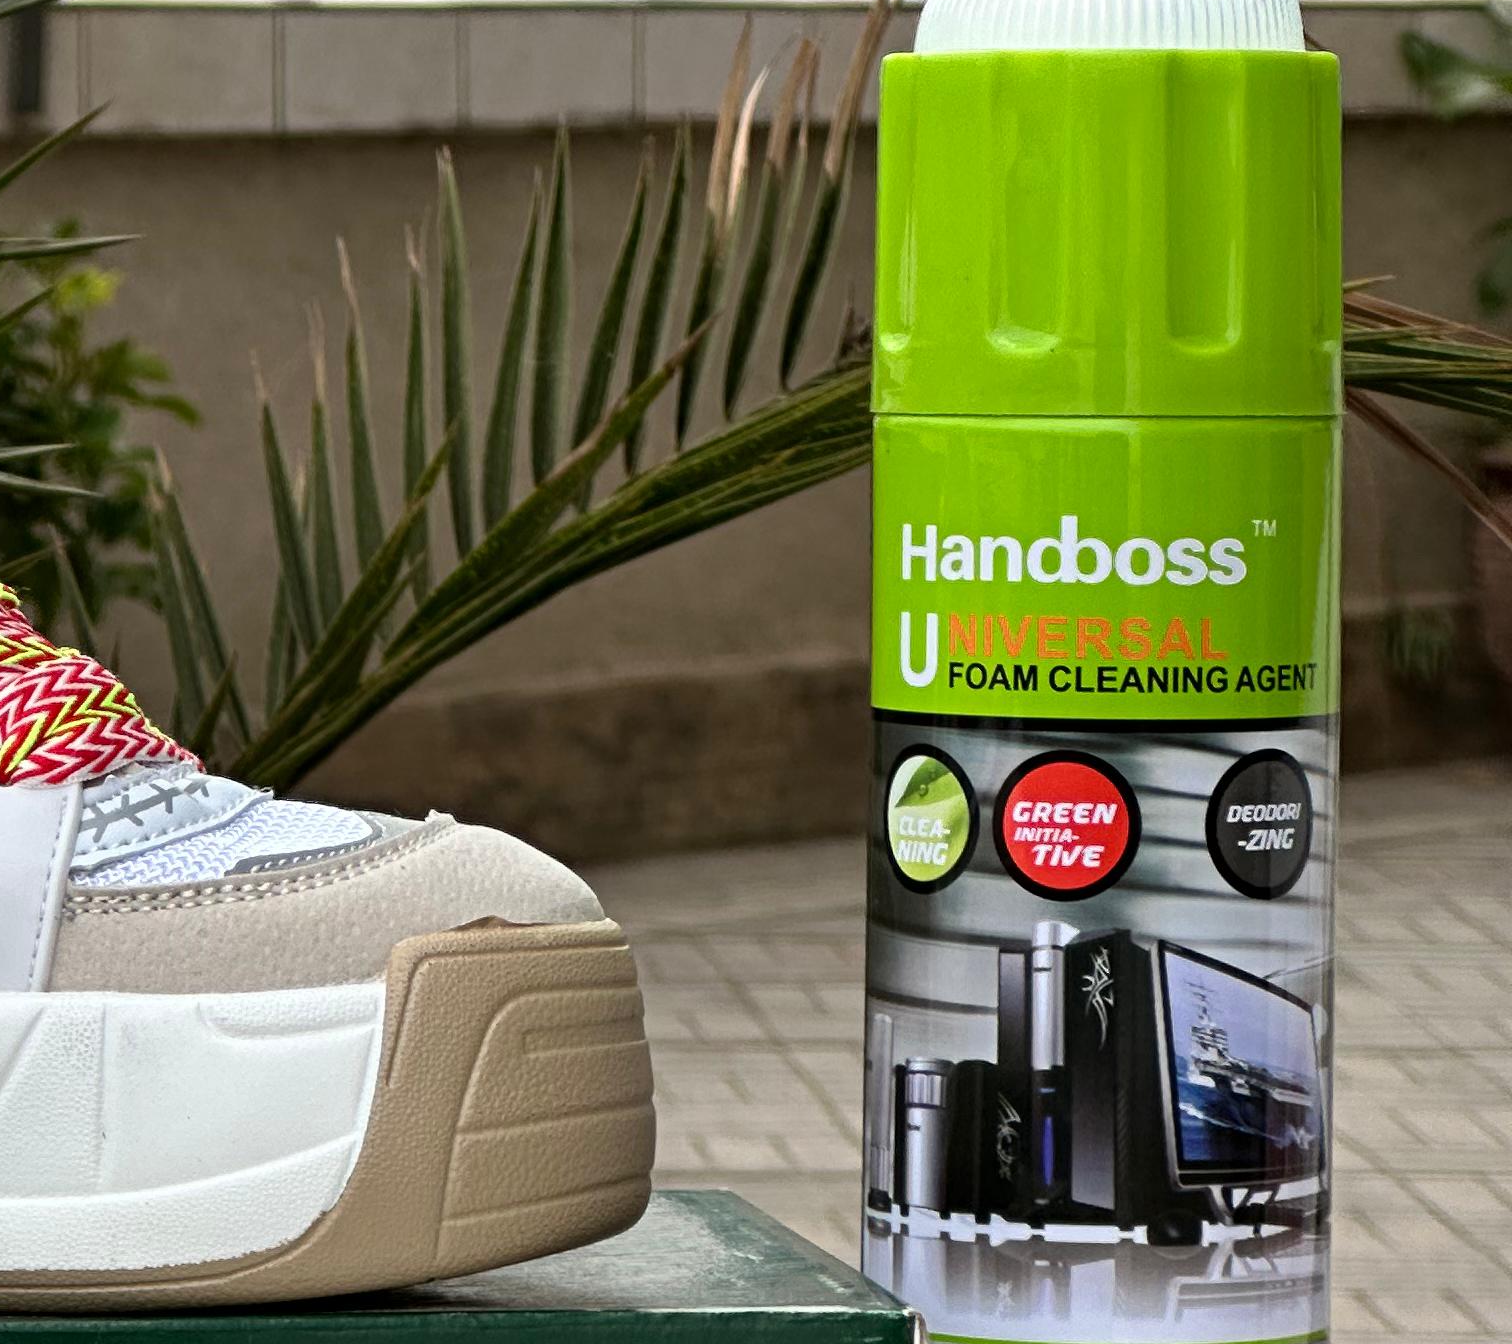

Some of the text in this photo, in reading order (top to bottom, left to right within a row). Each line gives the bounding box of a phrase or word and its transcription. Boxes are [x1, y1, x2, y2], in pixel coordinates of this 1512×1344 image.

[901, 515, 1248, 586] Handboss
[947, 661, 1318, 694] FOAM CLEANING AGENT
[1012, 800, 1118, 825] GREEN
[1013, 827, 1080, 844] INITIA-
[1238, 827, 1296, 851] -ZING
[896, 839, 949, 865] NING
[1031, 843, 1105, 868] TIVE
